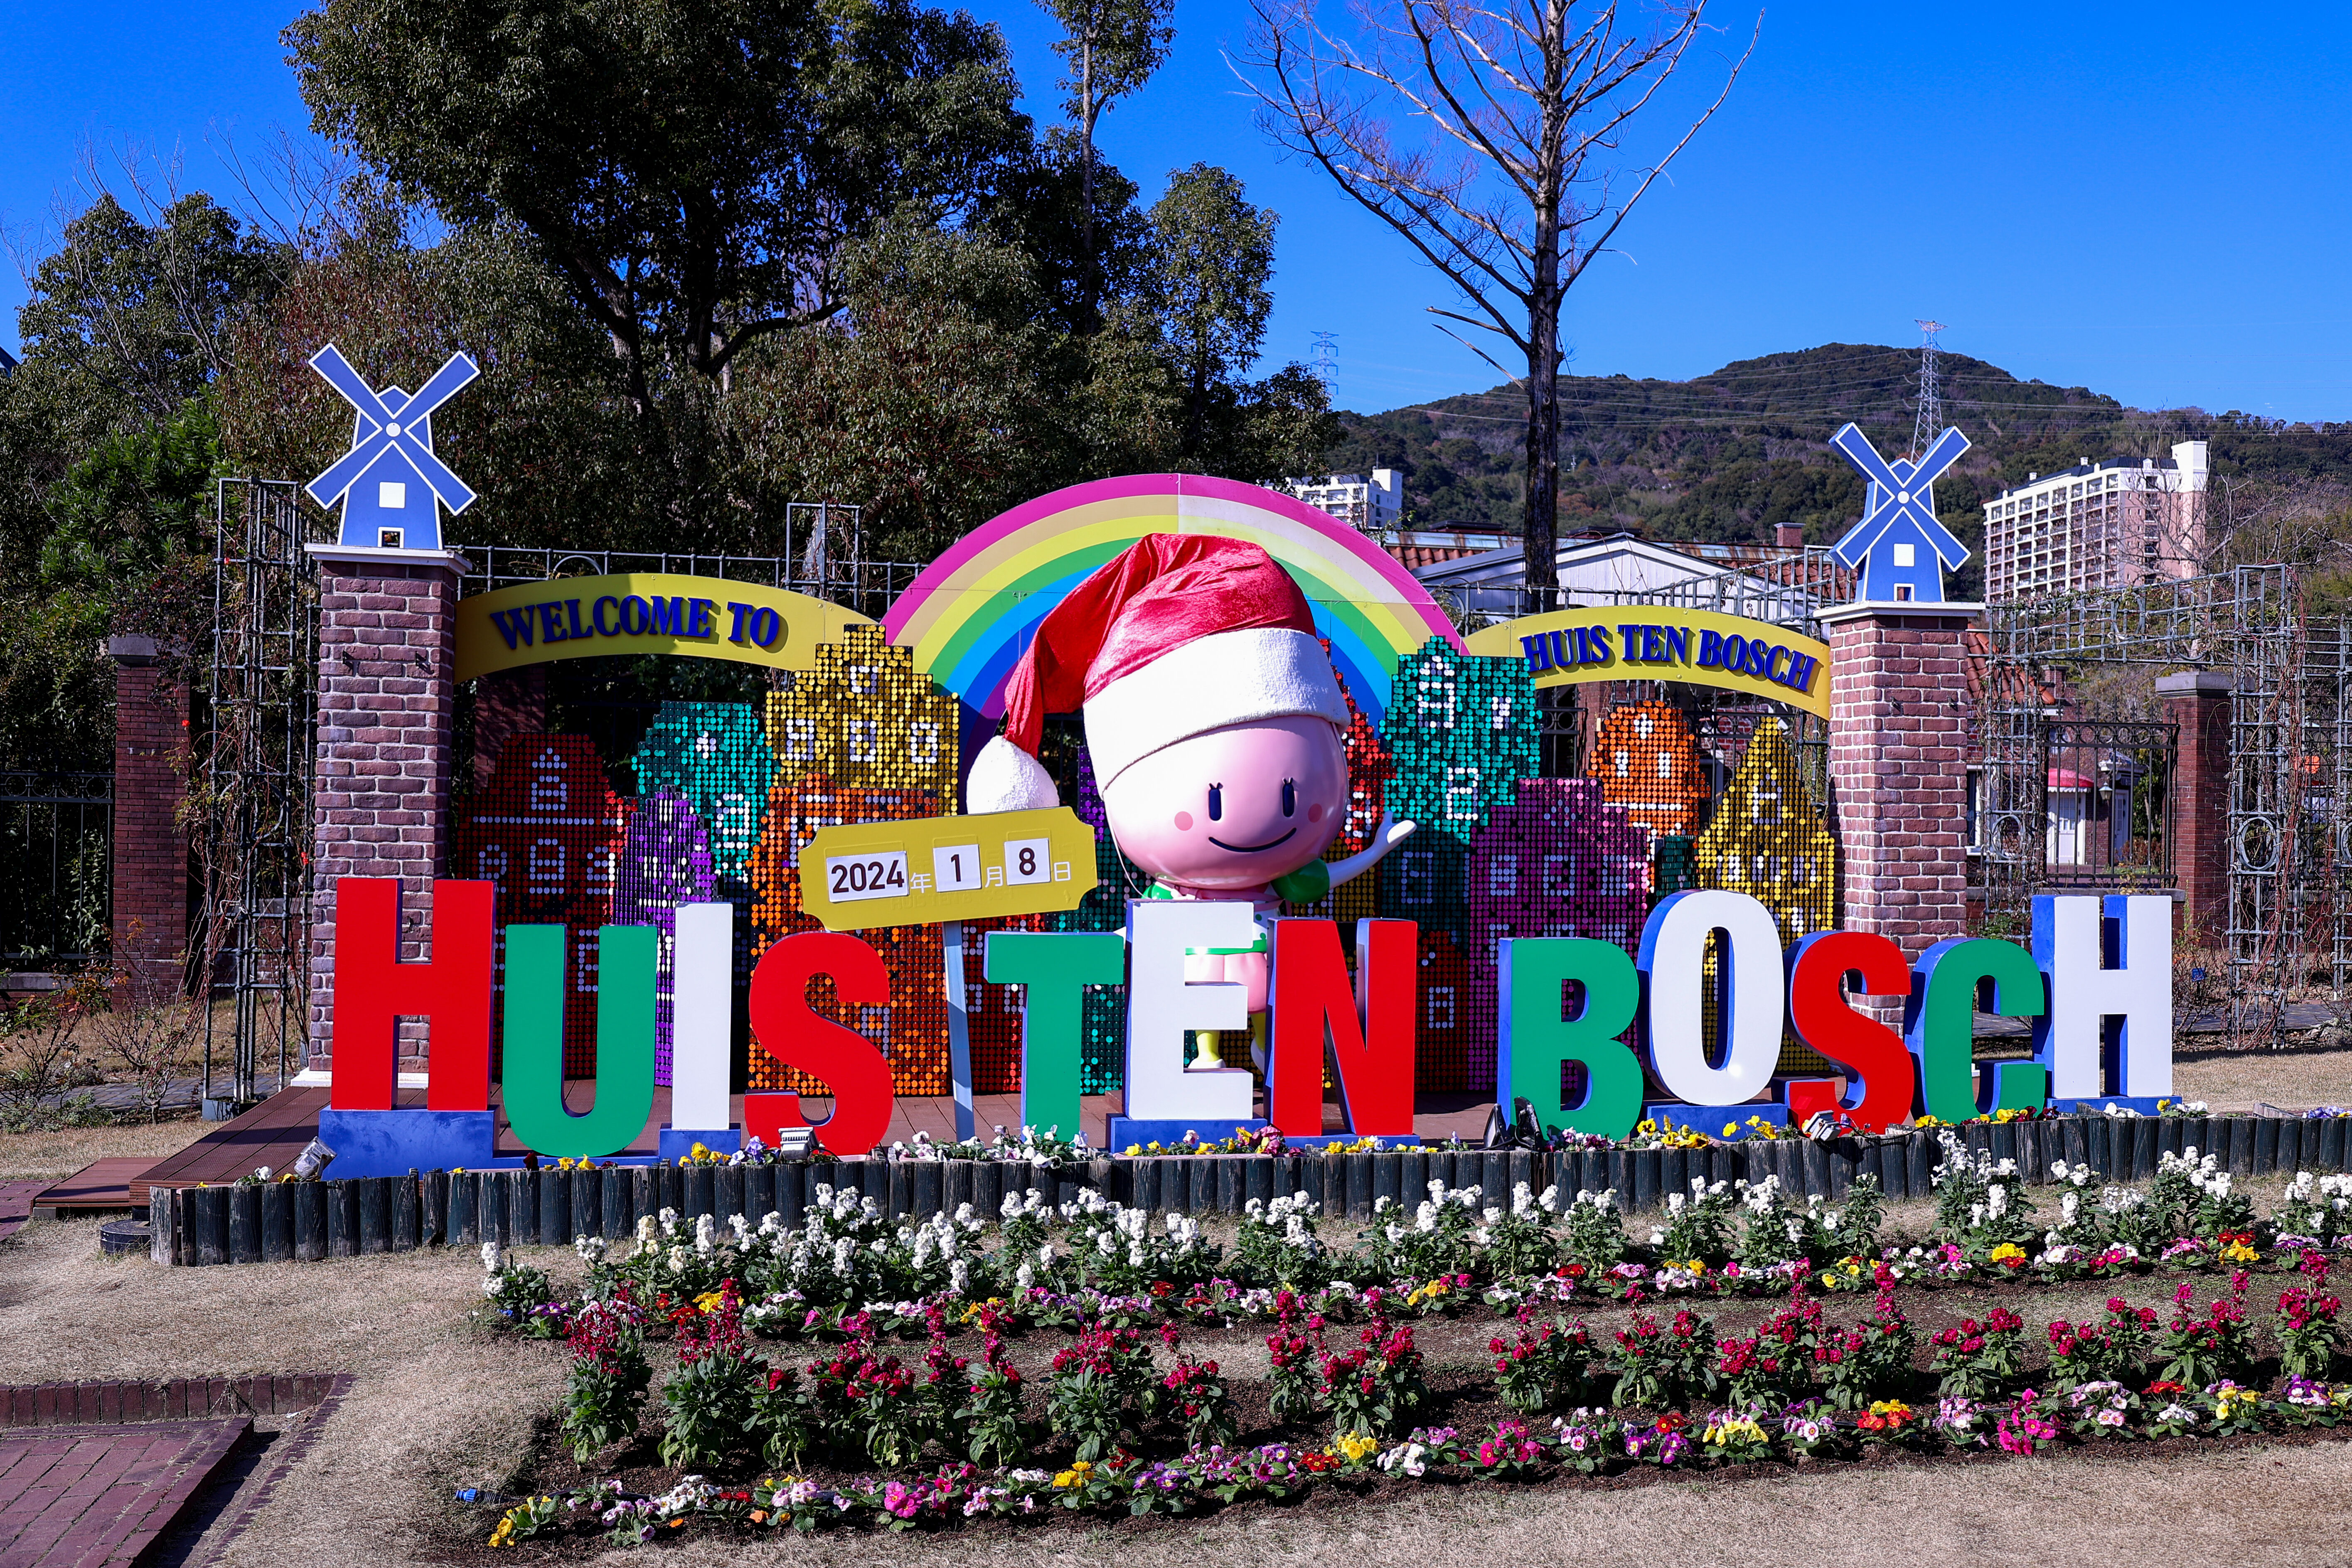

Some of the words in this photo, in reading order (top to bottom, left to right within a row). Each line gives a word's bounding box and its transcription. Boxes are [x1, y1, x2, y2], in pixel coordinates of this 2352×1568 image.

[490, 594, 712, 650] WELCOME
[727, 601, 780, 647] TO
[1519, 625, 1609, 672] HUIS
[1616, 624, 1690, 664] TEN
[1696, 628, 1819, 693] BOSCH
[331, 877, 894, 1158] HUIS
[984, 899, 1418, 1143] TEN
[1498, 889, 2172, 1140] BOSCH
